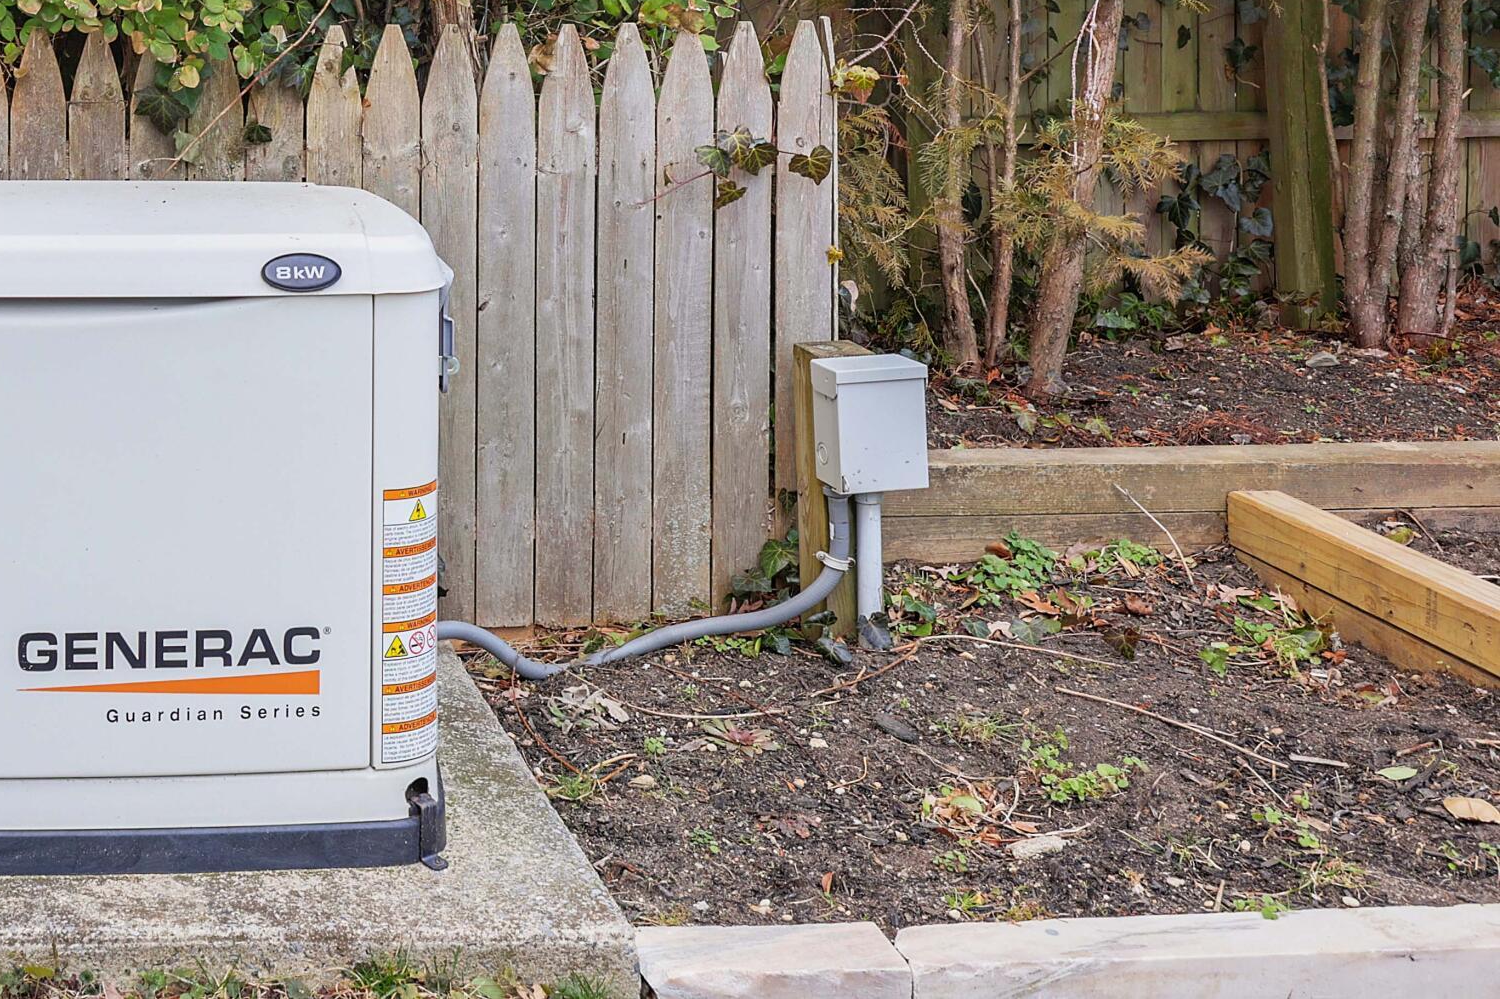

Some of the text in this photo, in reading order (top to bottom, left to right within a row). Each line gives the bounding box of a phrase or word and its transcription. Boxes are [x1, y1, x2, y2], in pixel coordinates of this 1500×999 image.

[275, 265, 325, 280] 8kW
[106, 704, 321, 723] Guardian Series
